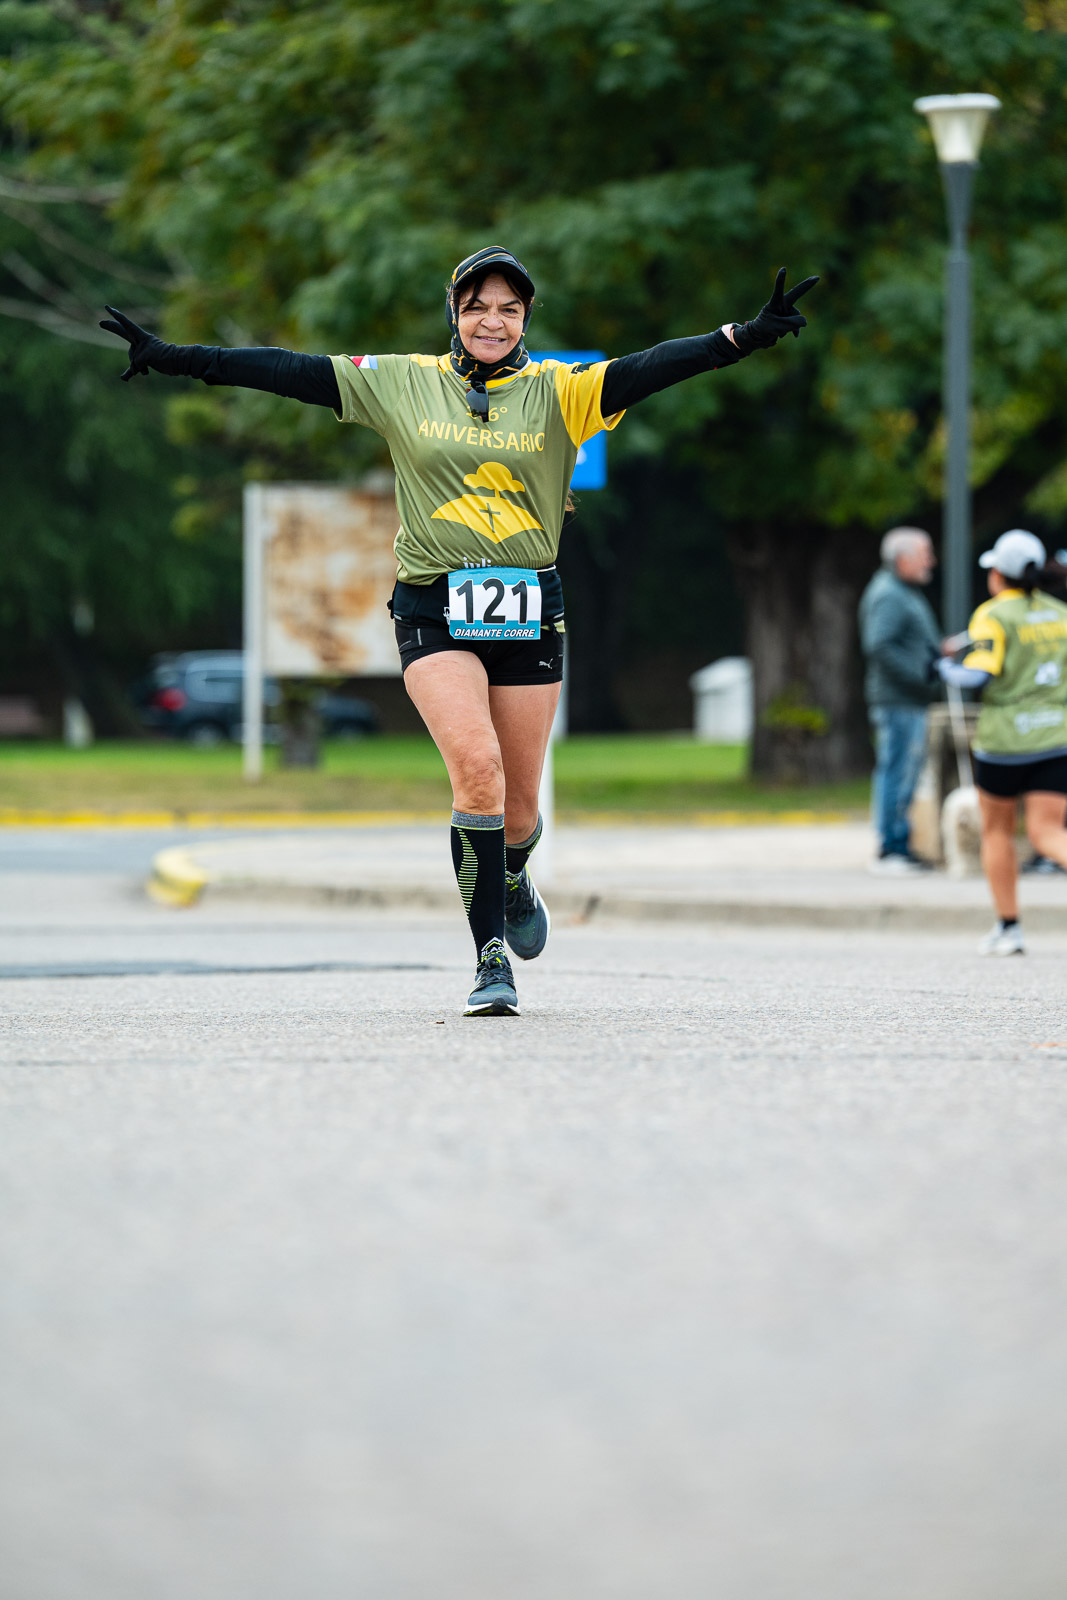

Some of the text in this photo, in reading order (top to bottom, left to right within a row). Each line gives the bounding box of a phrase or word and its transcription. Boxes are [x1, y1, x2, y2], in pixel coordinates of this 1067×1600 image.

[418, 419, 545, 453] ANIVERSARIO
[456, 577, 528, 625] 121
[454, 628, 536, 638] DIAMANTE CORRE
